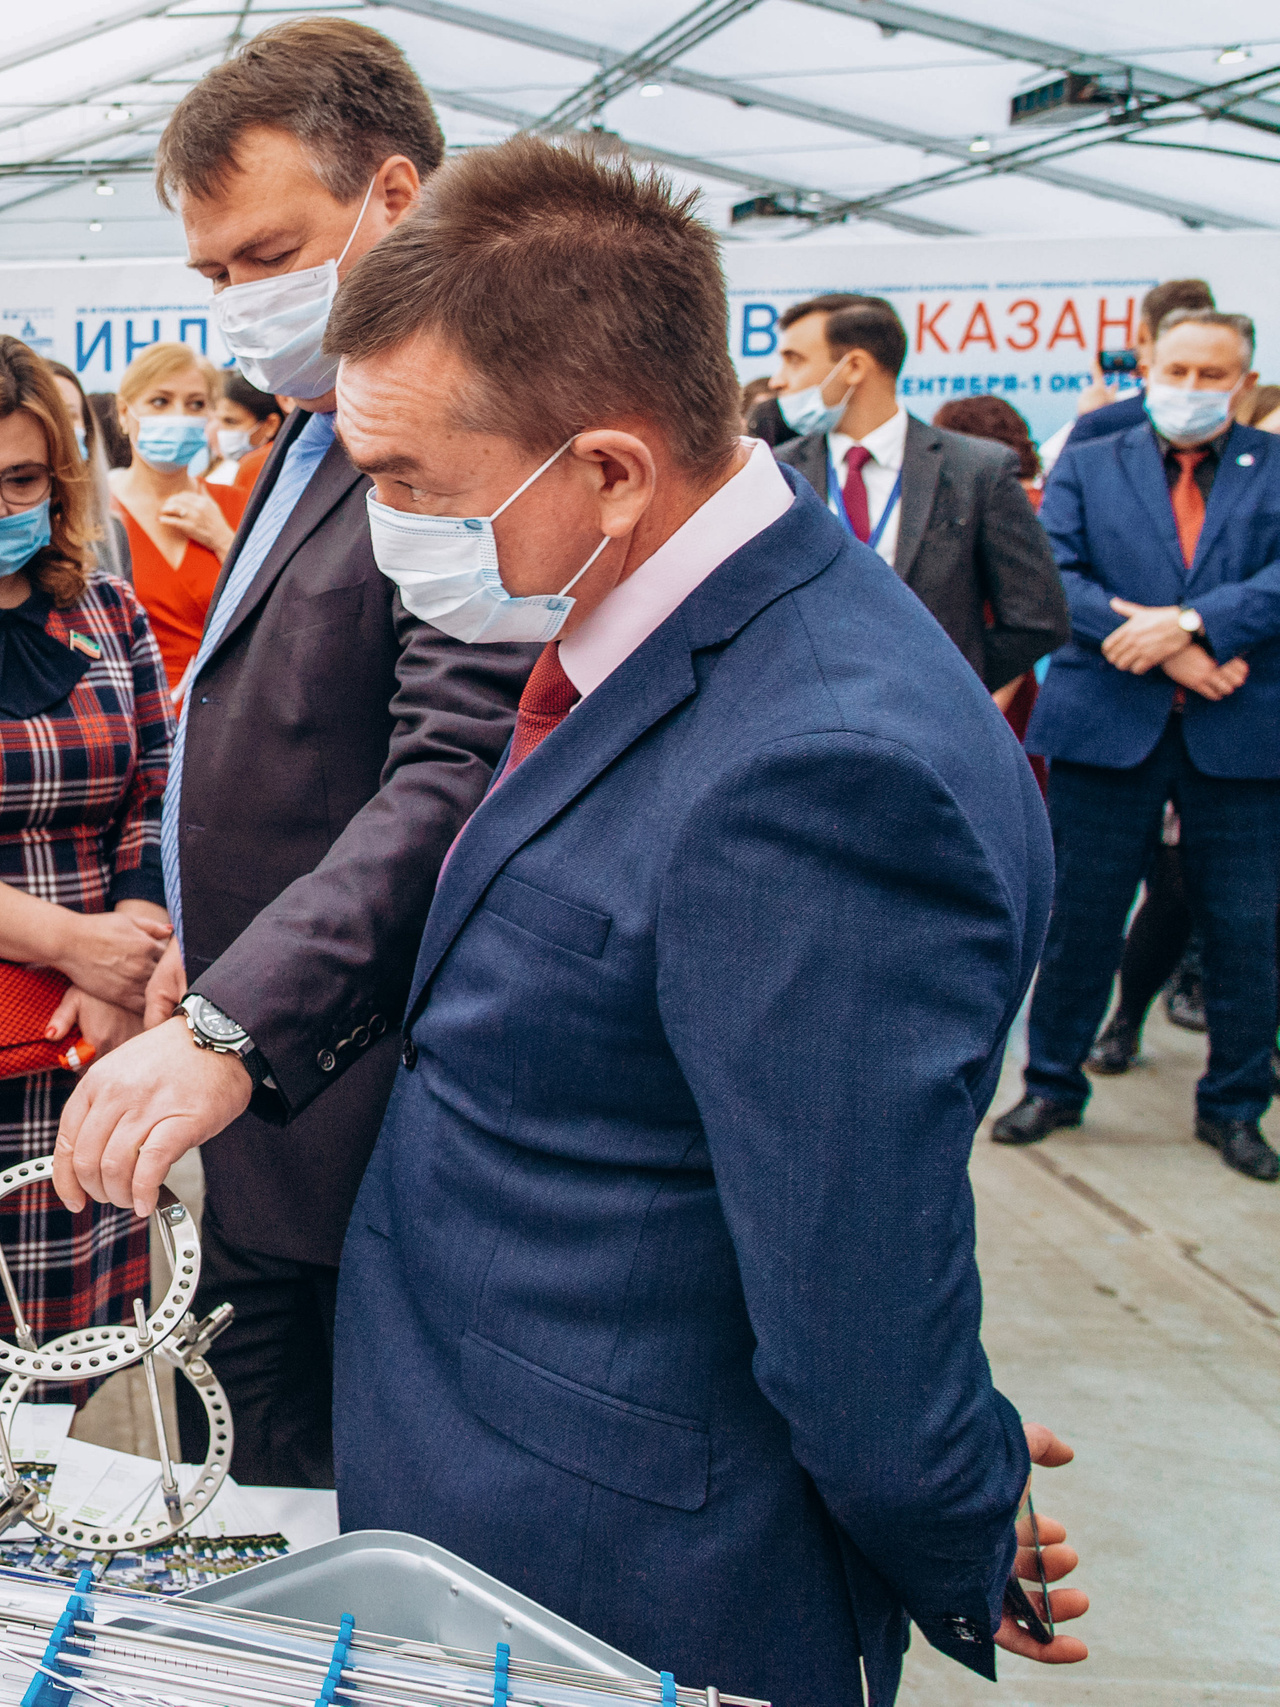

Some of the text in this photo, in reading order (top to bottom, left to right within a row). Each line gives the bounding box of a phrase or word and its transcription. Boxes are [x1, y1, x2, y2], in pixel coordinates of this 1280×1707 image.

[76, 318, 236, 373] ИНД
[916, 298, 1136, 354] КАЗАН
[902, 374, 1041, 396] ЕНТЯБРЯ-1
